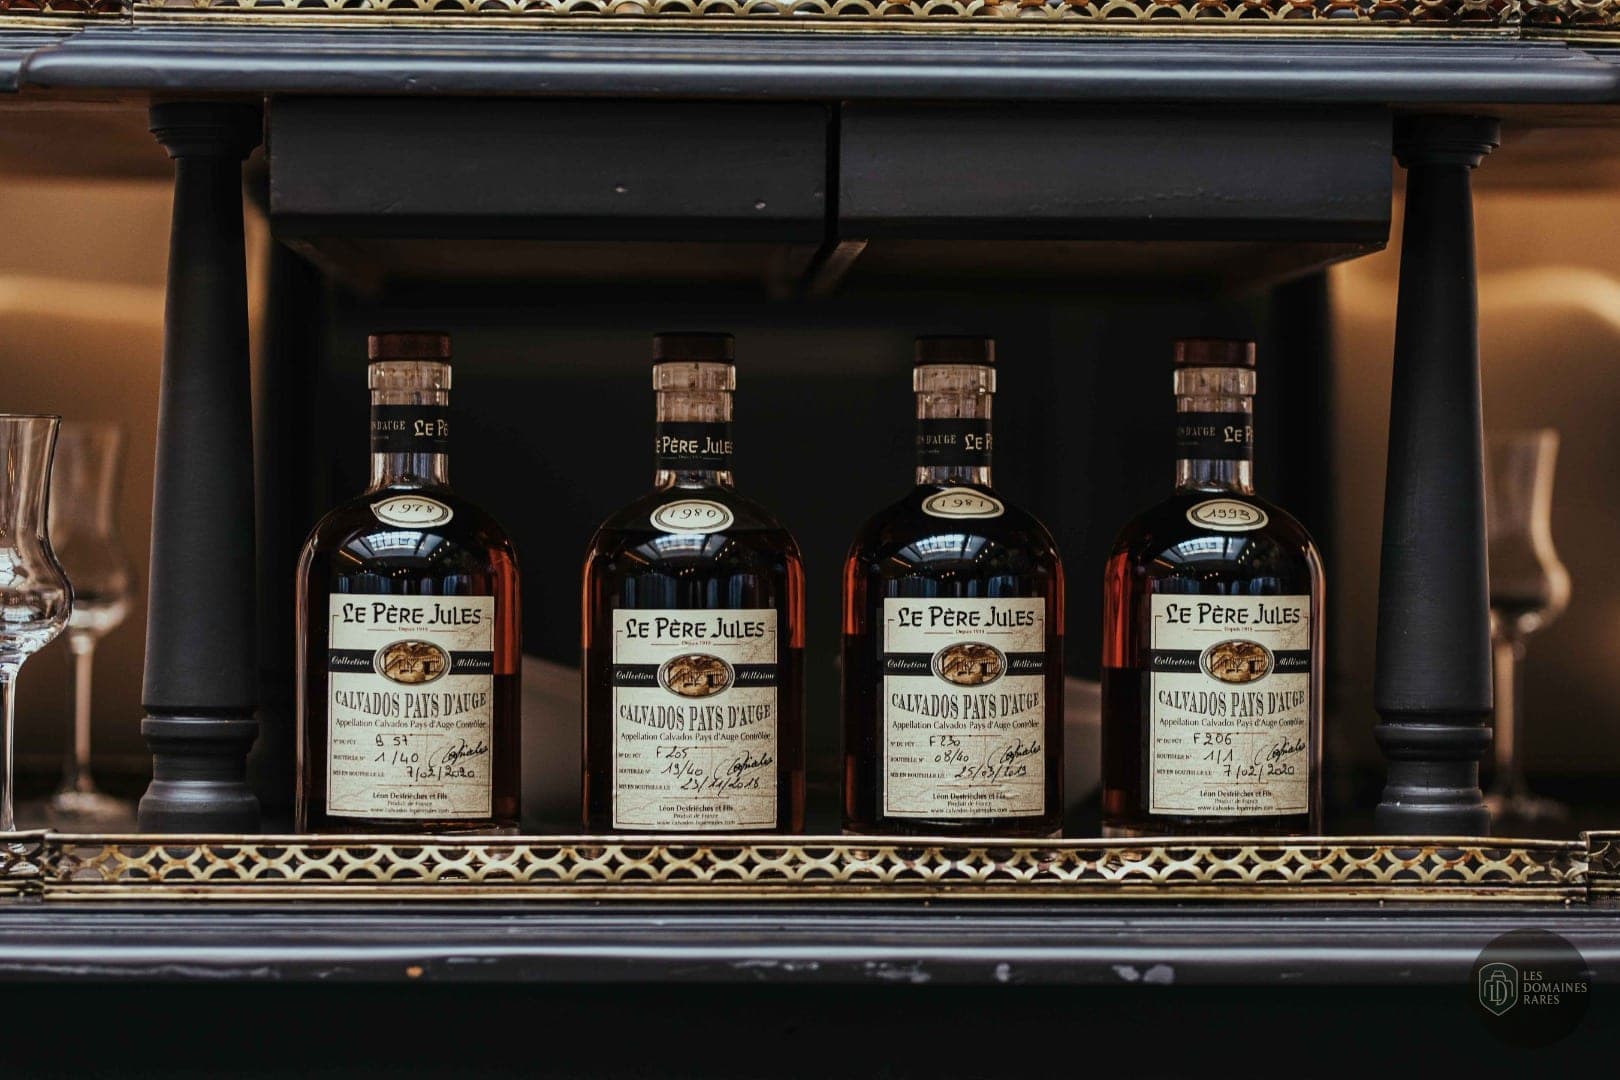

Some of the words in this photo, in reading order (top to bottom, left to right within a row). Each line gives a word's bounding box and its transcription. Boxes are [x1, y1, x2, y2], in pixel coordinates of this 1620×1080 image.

[414, 420, 434, 436] LE
[1224, 426, 1242, 442] LE
[965, 434, 982, 450] LE
[388, 503, 434, 513] 1978
[941, 499, 983, 507] 1981
[670, 508, 716, 519] 1980
[342, 603, 366, 623] LE
[371, 602, 424, 624] PÈRE
[428, 603, 482, 625] JULES
[898, 608, 923, 627] LE
[928, 606, 981, 627] PÈRE
[984, 606, 1034, 627] JULES
[1166, 603, 1191, 623] LE
[1197, 602, 1249, 624] PÈRE
[1252, 603, 1300, 624] JULES
[626, 618, 650, 638] LE
[655, 617, 707, 638] PÈRE
[711, 617, 765, 638] JULES
[331, 655, 370, 666] Collection
[887, 659, 927, 669] Collection
[1154, 656, 1195, 665] Collection
[616, 670, 654, 680] Collection
[335, 691, 400, 718] CALVADOS
[405, 693, 439, 718] PAYS
[443, 692, 487, 716] D'AUGE
[891, 692, 959, 719] CALVADOS
[963, 694, 997, 719] PAYS
[1000, 692, 1039, 716] D'AUGE
[1158, 690, 1226, 717] CALVADOS
[1230, 692, 1264, 718] PAYS
[1268, 690, 1304, 715] D'AUGE
[335, 718, 372, 728] Appellation
[375, 720, 408, 728] Calvados
[410, 720, 427, 729] Pays
[429, 720, 454, 729] d'Auge
[620, 704, 685, 731] CALVADOS
[689, 706, 724, 731] PAYS
[728, 704, 770, 729] D'AUGE
[1159, 718, 1199, 727] Appellation
[1237, 719, 1253, 728] Pays
[1254, 718, 1278, 728] d'Auge
[892, 721, 931, 730] Appellation
[933, 721, 967, 729] Calvados
[969, 721, 986, 730] Pays
[987, 721, 1011, 730] d'Auge
[620, 732, 658, 741] Appellation
[660, 732, 693, 740] Calvados
[695, 733, 712, 742] Pays
[713, 732, 738, 742] d'Auge
